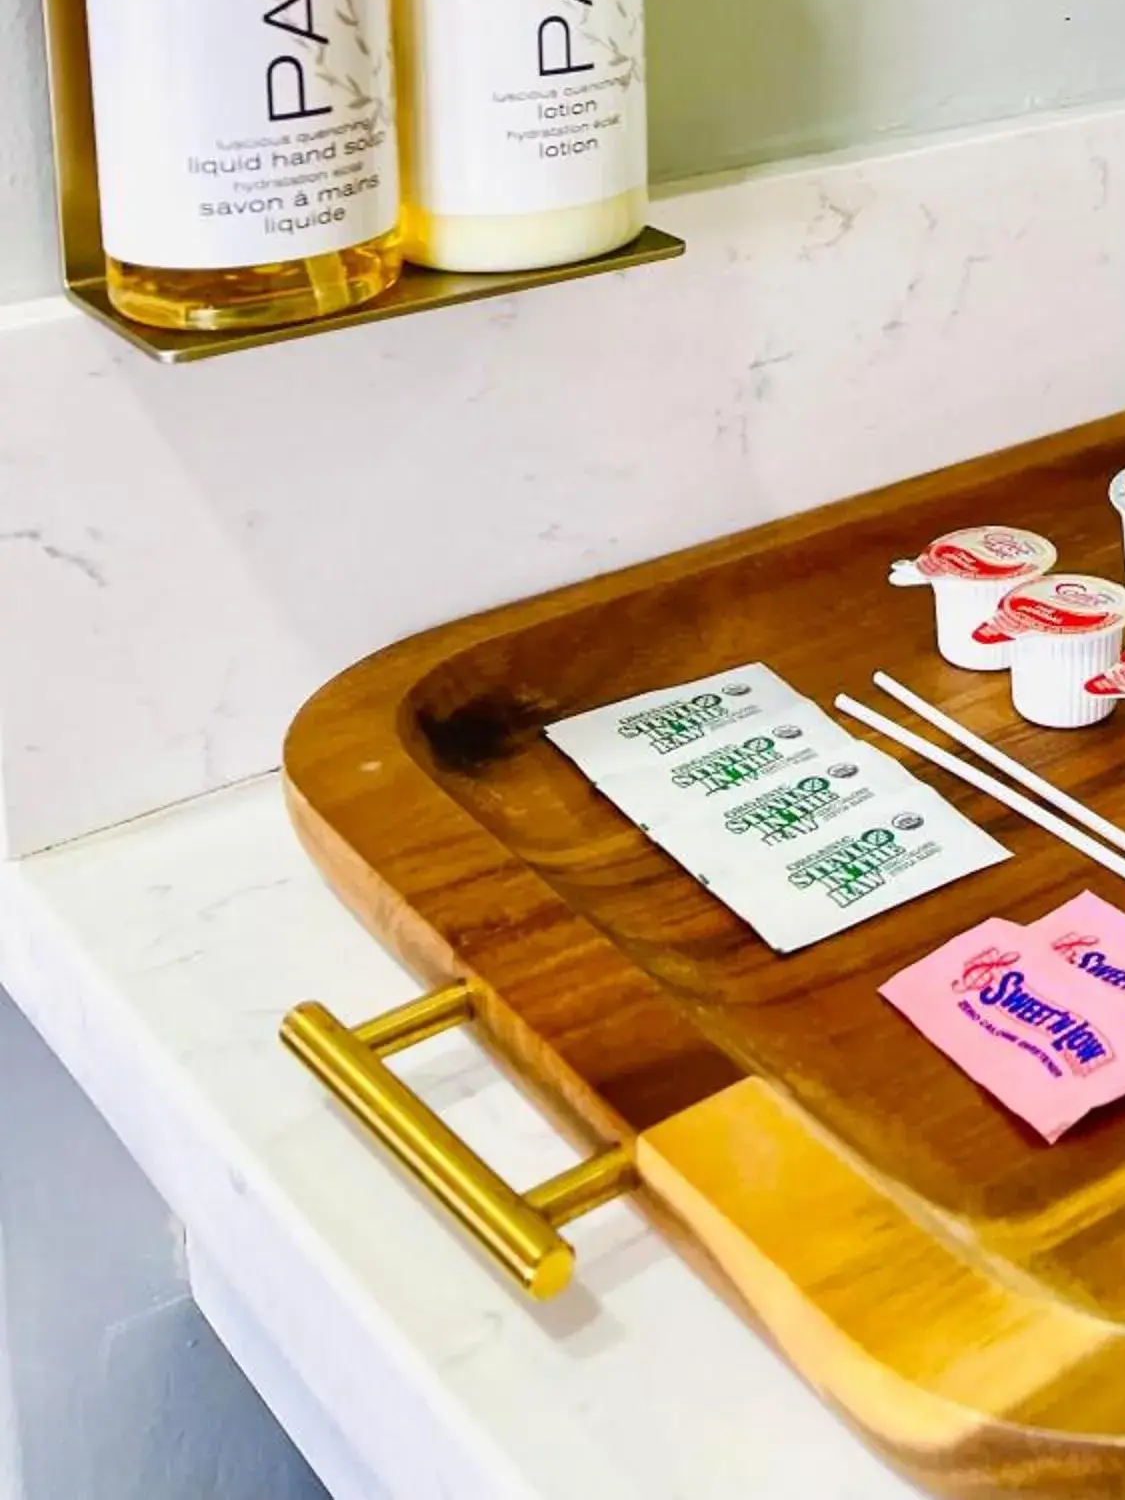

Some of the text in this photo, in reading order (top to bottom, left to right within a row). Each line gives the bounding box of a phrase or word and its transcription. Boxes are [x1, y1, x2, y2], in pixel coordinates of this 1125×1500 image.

[537, 98, 598, 121] lotion
[188, 153, 262, 176] liquid
[271, 140, 337, 169] hand
[538, 136, 599, 160] lotion
[199, 195, 285, 217] savon
[317, 172, 381, 204] mains
[264, 206, 346, 236] liquide
[788, 840, 876, 889] STEVIA
[826, 869, 886, 909] RAW
